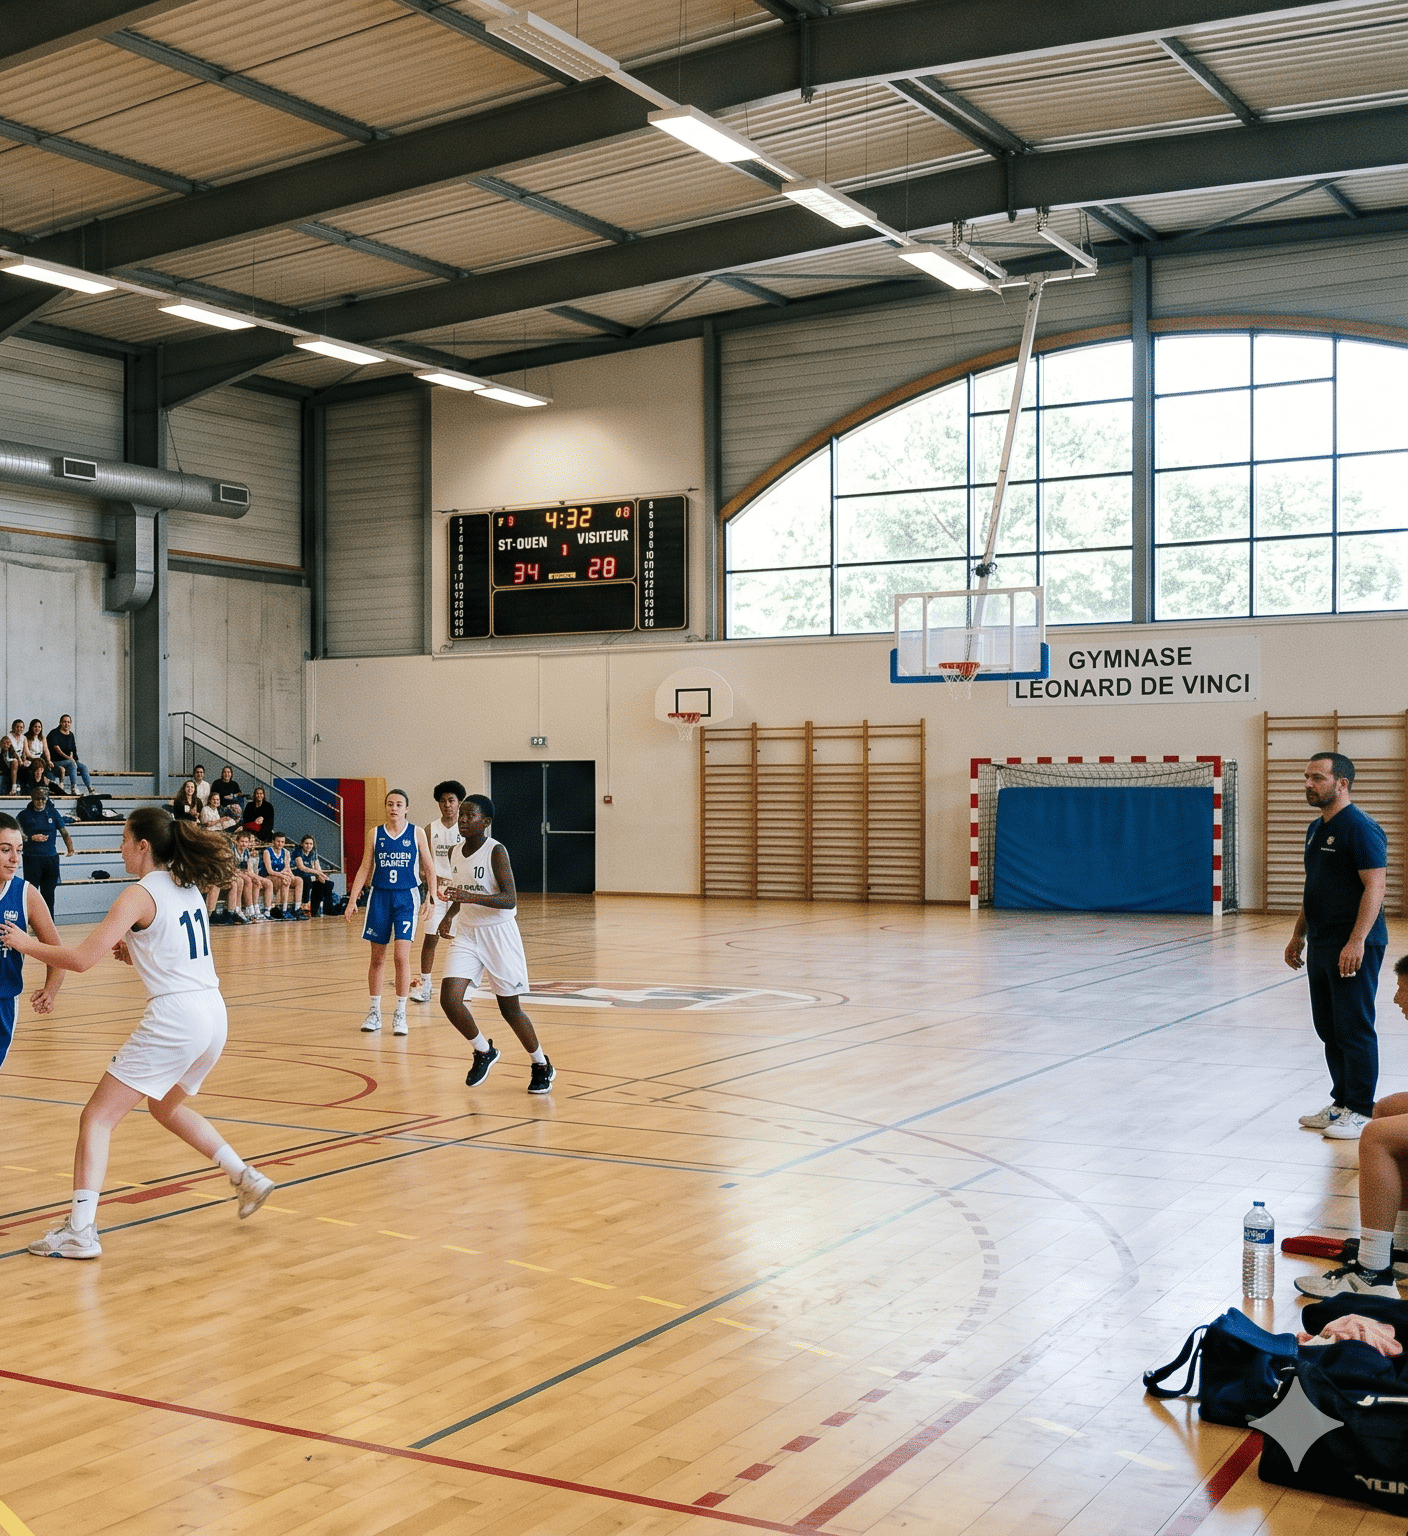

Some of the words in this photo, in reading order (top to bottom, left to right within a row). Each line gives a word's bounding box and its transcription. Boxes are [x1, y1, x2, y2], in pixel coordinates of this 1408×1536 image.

[545, 507, 592, 529] 4:32
[498, 536, 548, 551] ST-OUEN
[577, 529, 629, 544] VISITEUR
[514, 563, 539, 583] 34
[588, 557, 615, 579] 28
[1069, 647, 1192, 670] GYMNASE
[1141, 676, 1174, 695] DE
[1182, 673, 1250, 694] VINCI
[389, 869, 398, 883] 9
[473, 866, 485, 879] 10
[179, 908, 209, 960] 11
[402, 921, 411, 934] 7
